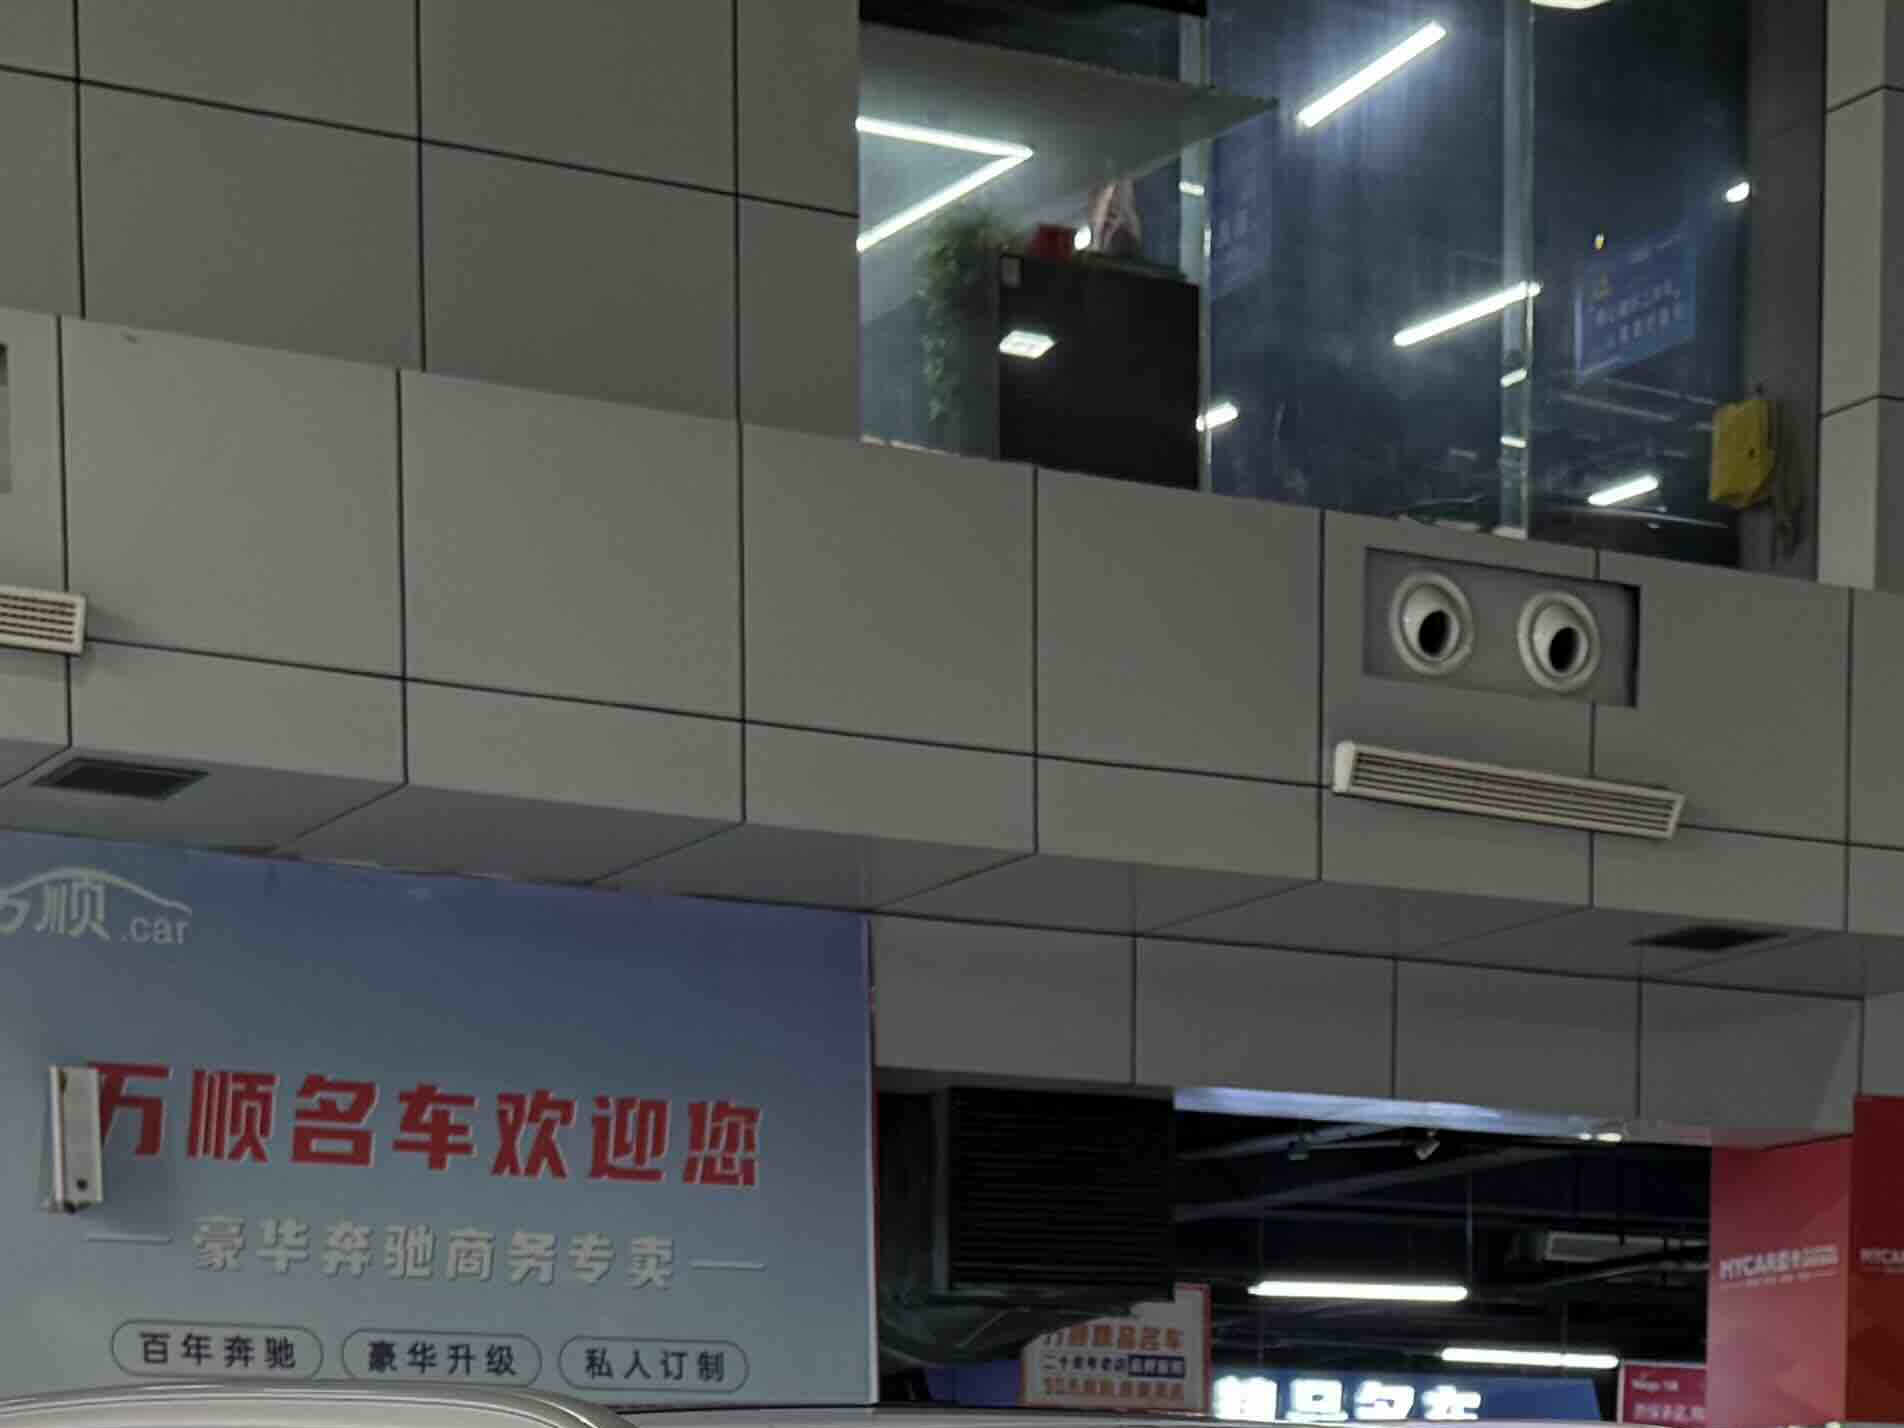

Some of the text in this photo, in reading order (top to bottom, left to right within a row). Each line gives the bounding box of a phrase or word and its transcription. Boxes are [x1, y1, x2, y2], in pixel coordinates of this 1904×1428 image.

[91, 1063, 763, 1189] 万顺名车欢迎您
[192, 1216, 677, 1291] 豪华奔驰商务专卖
[139, 1331, 726, 1384] 百年奔驰 豪华升级 私人订制
